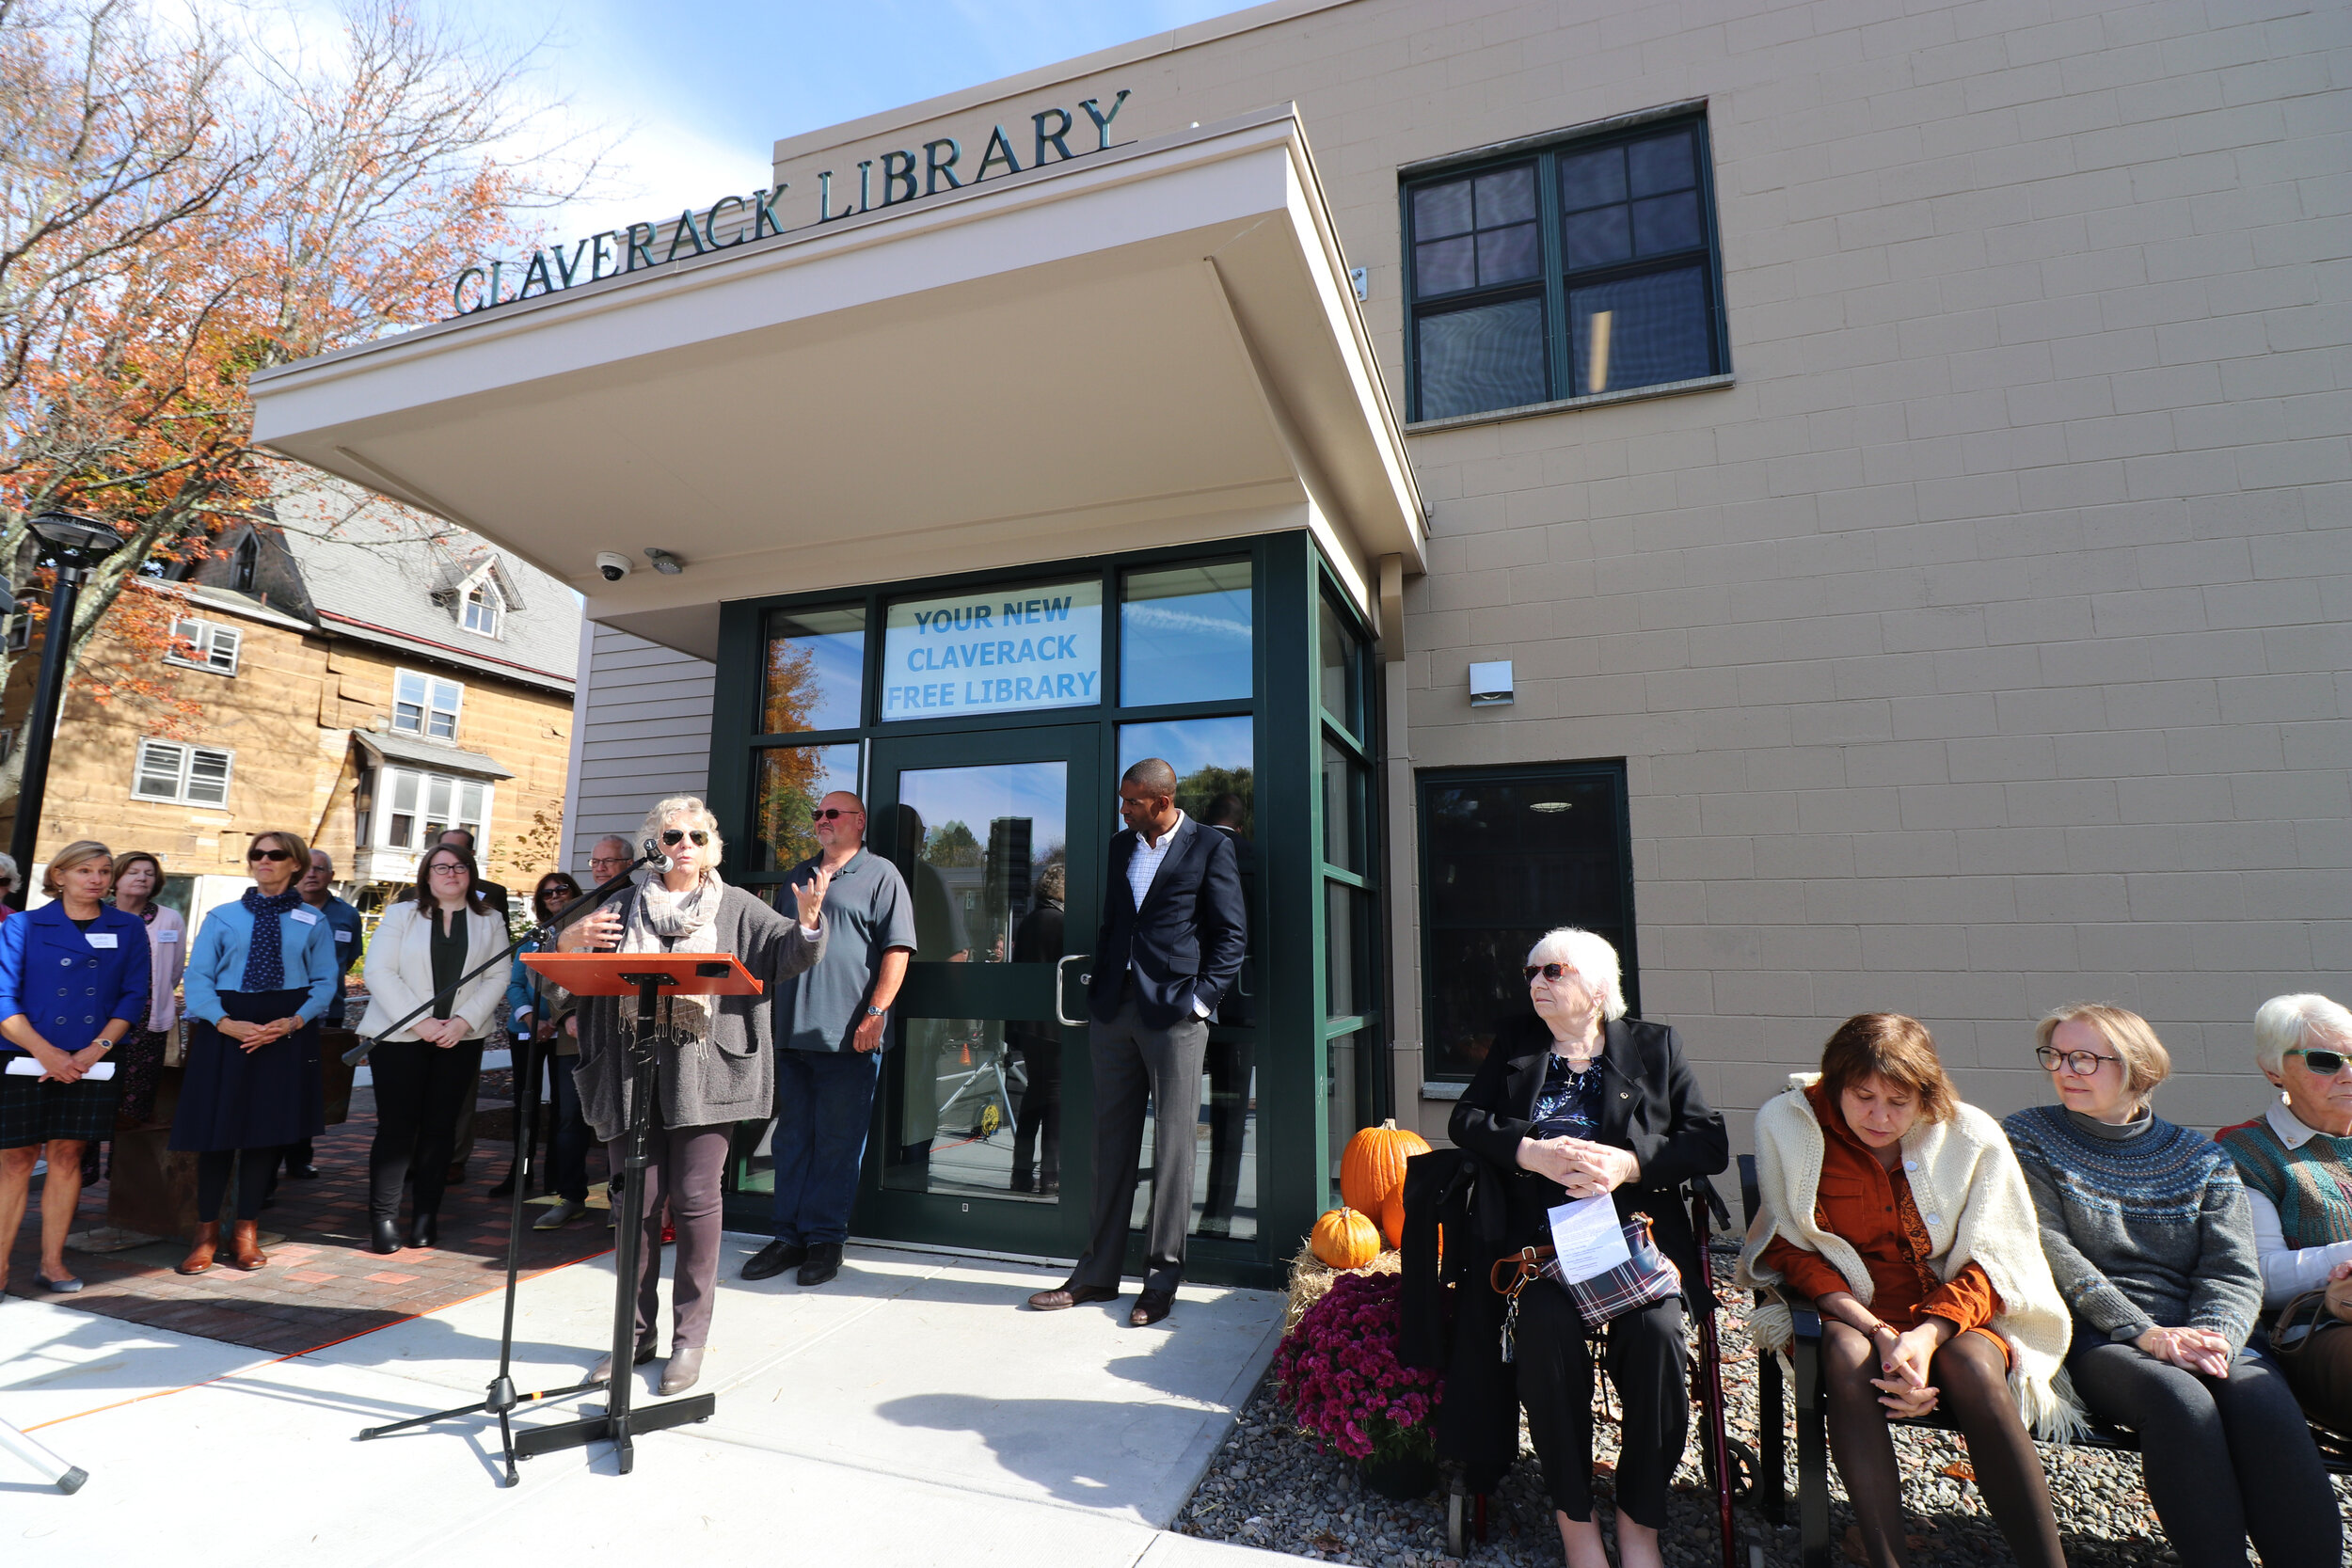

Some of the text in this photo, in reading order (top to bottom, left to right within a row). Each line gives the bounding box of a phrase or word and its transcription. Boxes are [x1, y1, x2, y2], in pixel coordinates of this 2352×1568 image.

[454, 89, 1132, 314] CLAVERACK LIBRARY
[914, 596, 1072, 635] YOUR NEW
[907, 634, 1077, 672] CLAVERACK
[887, 671, 1098, 710] FREE LIBRARY
